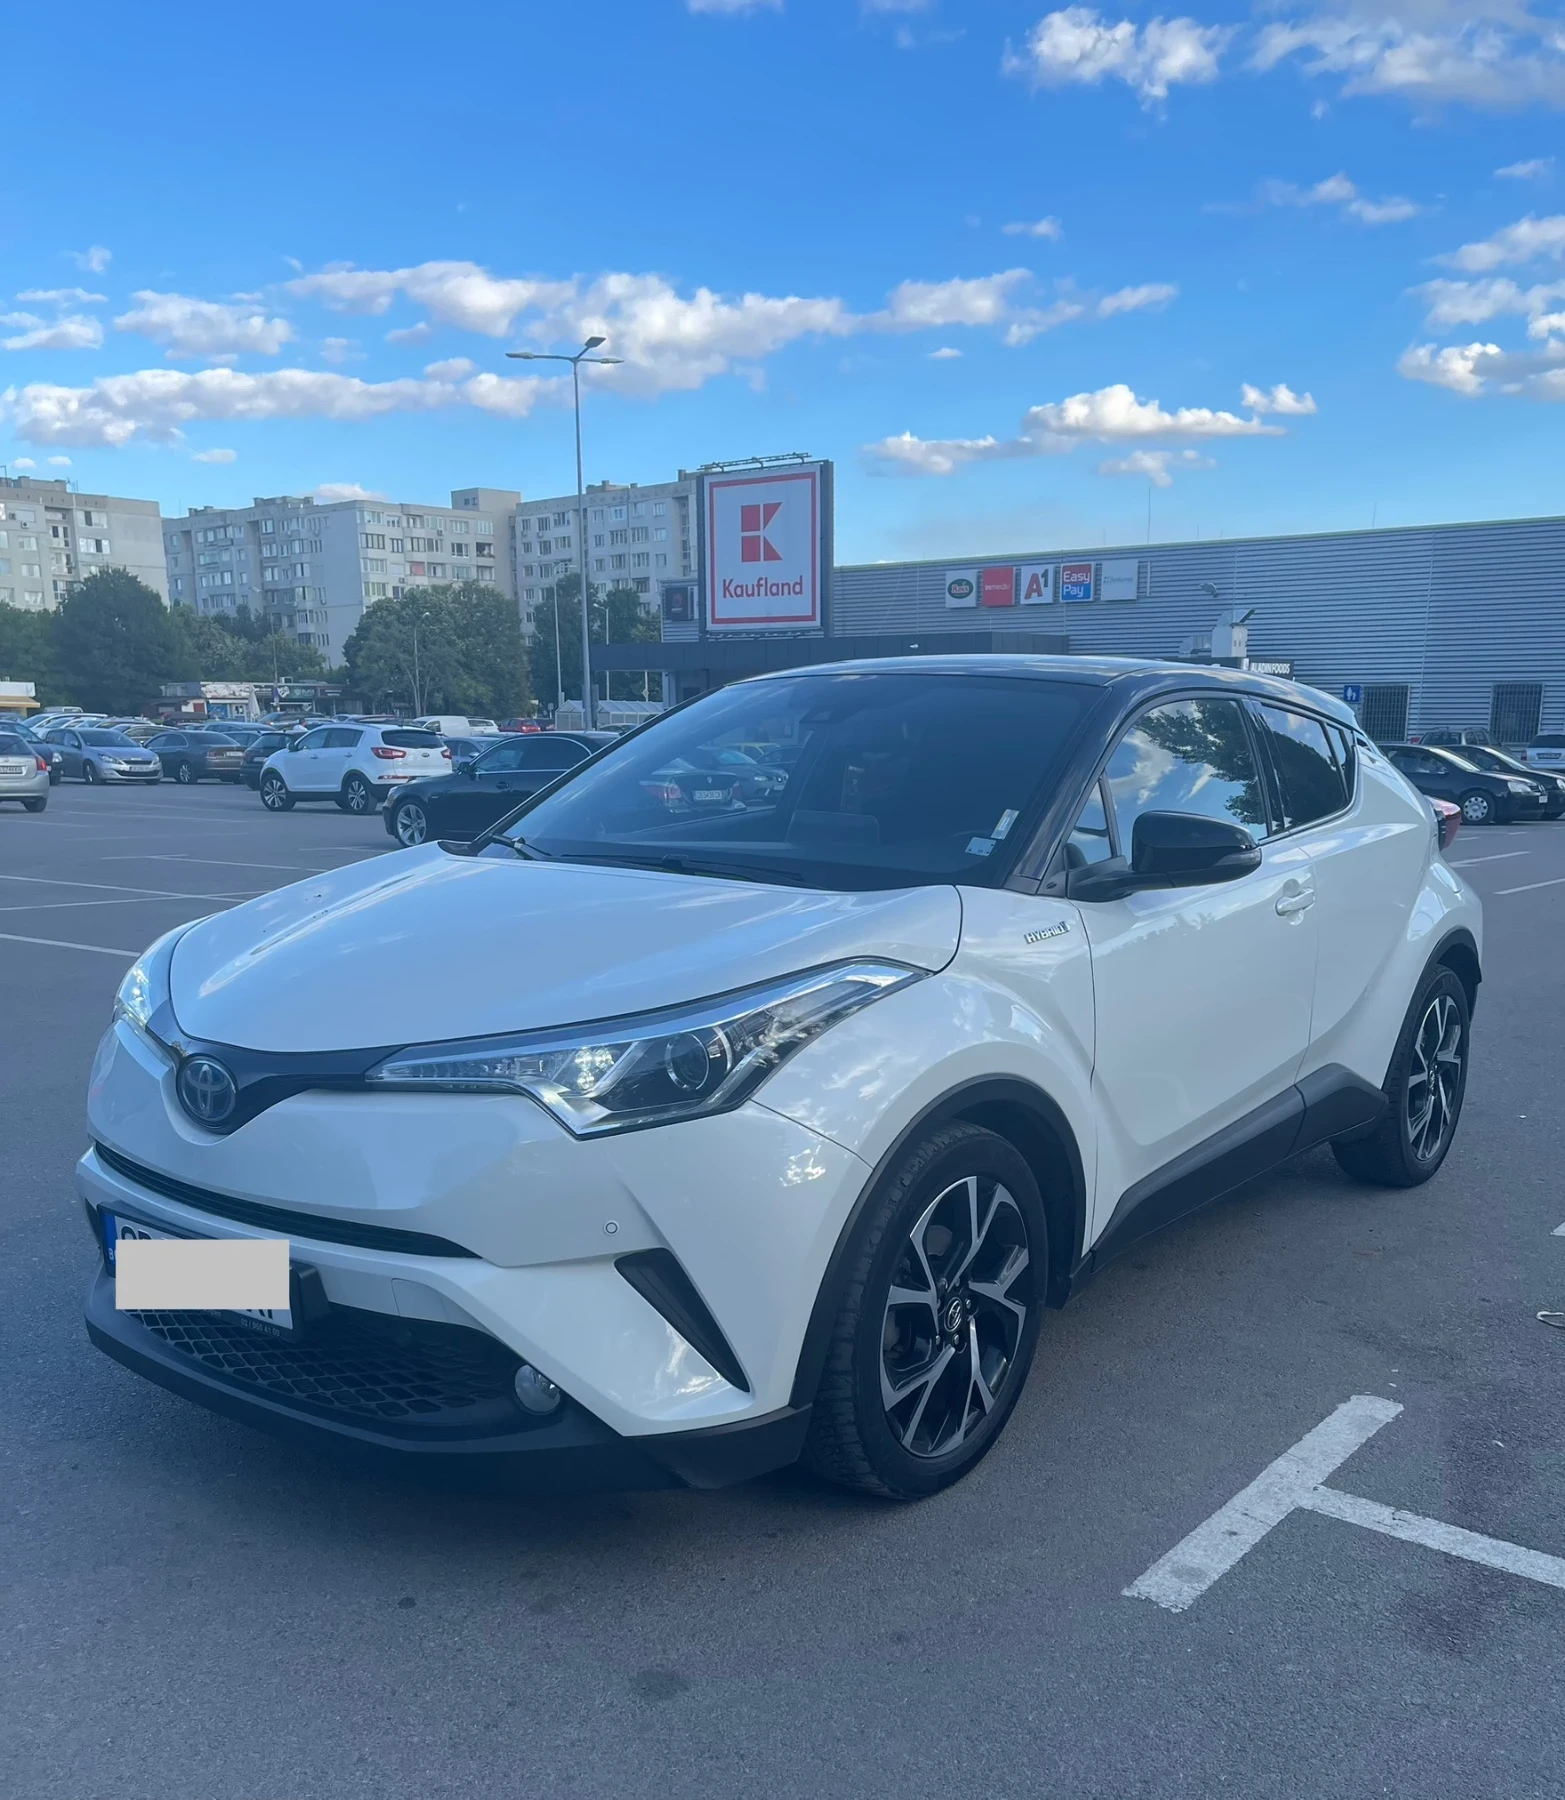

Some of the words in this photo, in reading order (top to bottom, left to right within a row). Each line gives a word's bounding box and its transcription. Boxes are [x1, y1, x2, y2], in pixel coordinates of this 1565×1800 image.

[723, 575, 803, 598] Kaufland
[1024, 569, 1049, 599] A1
[1063, 571, 1090, 583] Easy
[1063, 584, 1084, 597] Pay
[1024, 921, 1068, 944] HYBRID
